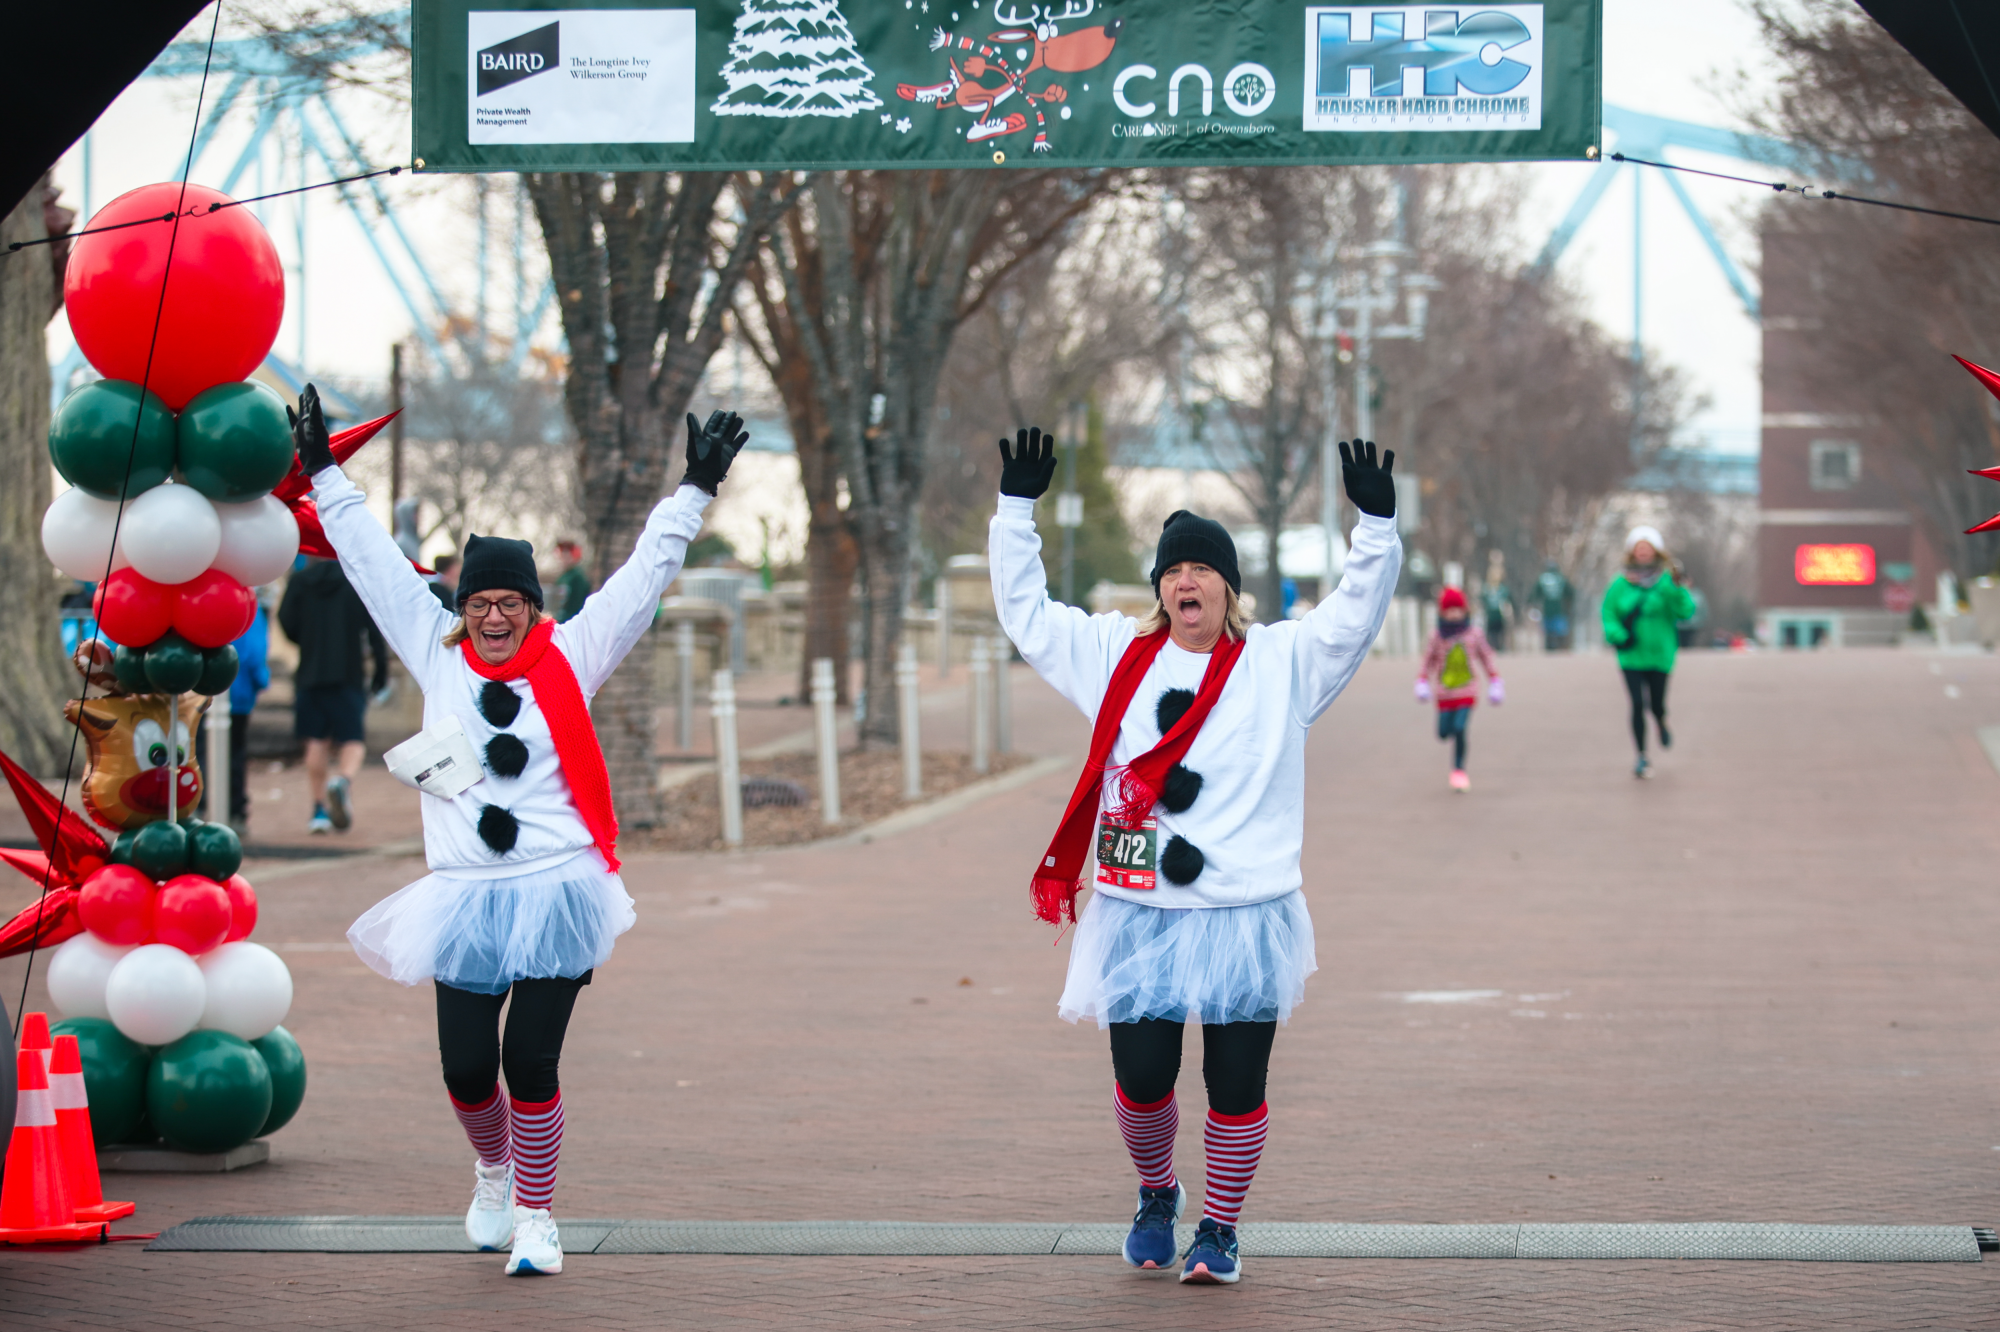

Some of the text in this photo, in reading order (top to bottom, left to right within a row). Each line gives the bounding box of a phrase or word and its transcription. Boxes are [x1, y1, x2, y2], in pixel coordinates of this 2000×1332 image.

[1316, 10, 1532, 96] HHC
[481, 53, 544, 73] BAIRD
[570, 56, 651, 69] The Longtine Ivey
[570, 69, 647, 81] Wilkerson Group
[1316, 96, 1529, 115] HAUSNER HARD CHROME
[477, 108, 531, 116] Private Wealth
[477, 118, 527, 126] Management
[1317, 115, 1527, 124] INCORPORATED
[1197, 123, 1208, 133] of
[1211, 122, 1275, 134] Owensboro
[1114, 833, 1147, 865] 472
